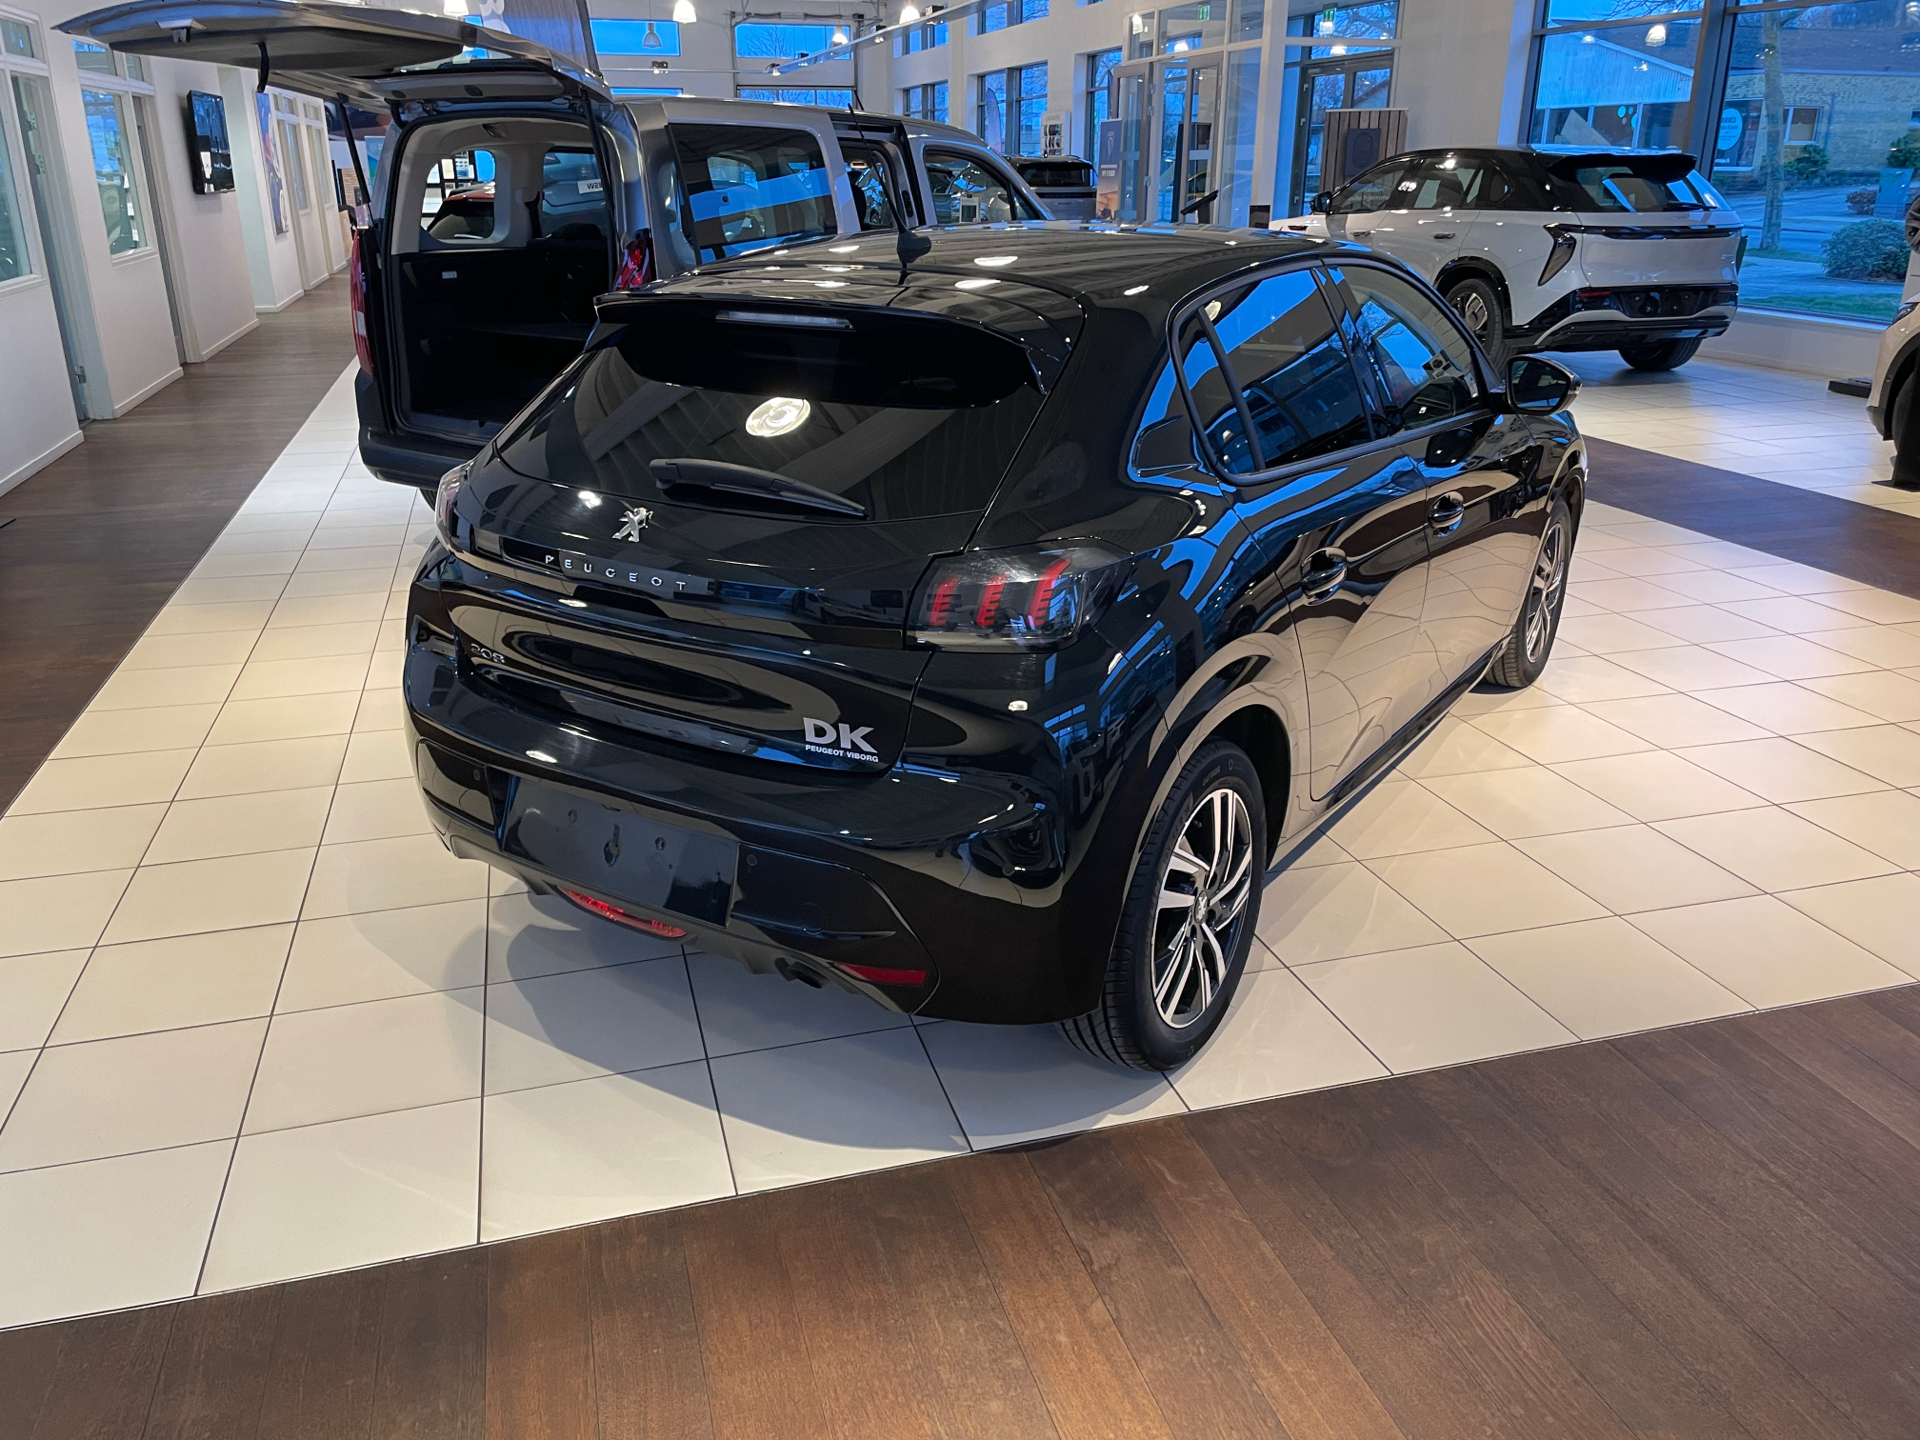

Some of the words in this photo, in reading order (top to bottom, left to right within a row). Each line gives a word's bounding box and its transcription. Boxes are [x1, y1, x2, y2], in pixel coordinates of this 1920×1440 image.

[545, 554, 687, 591] PEUGEOT
[471, 643, 506, 664] 208
[803, 717, 878, 753] DK
[805, 744, 845, 757] PEUGEOT
[846, 751, 879, 763] VIBORG
